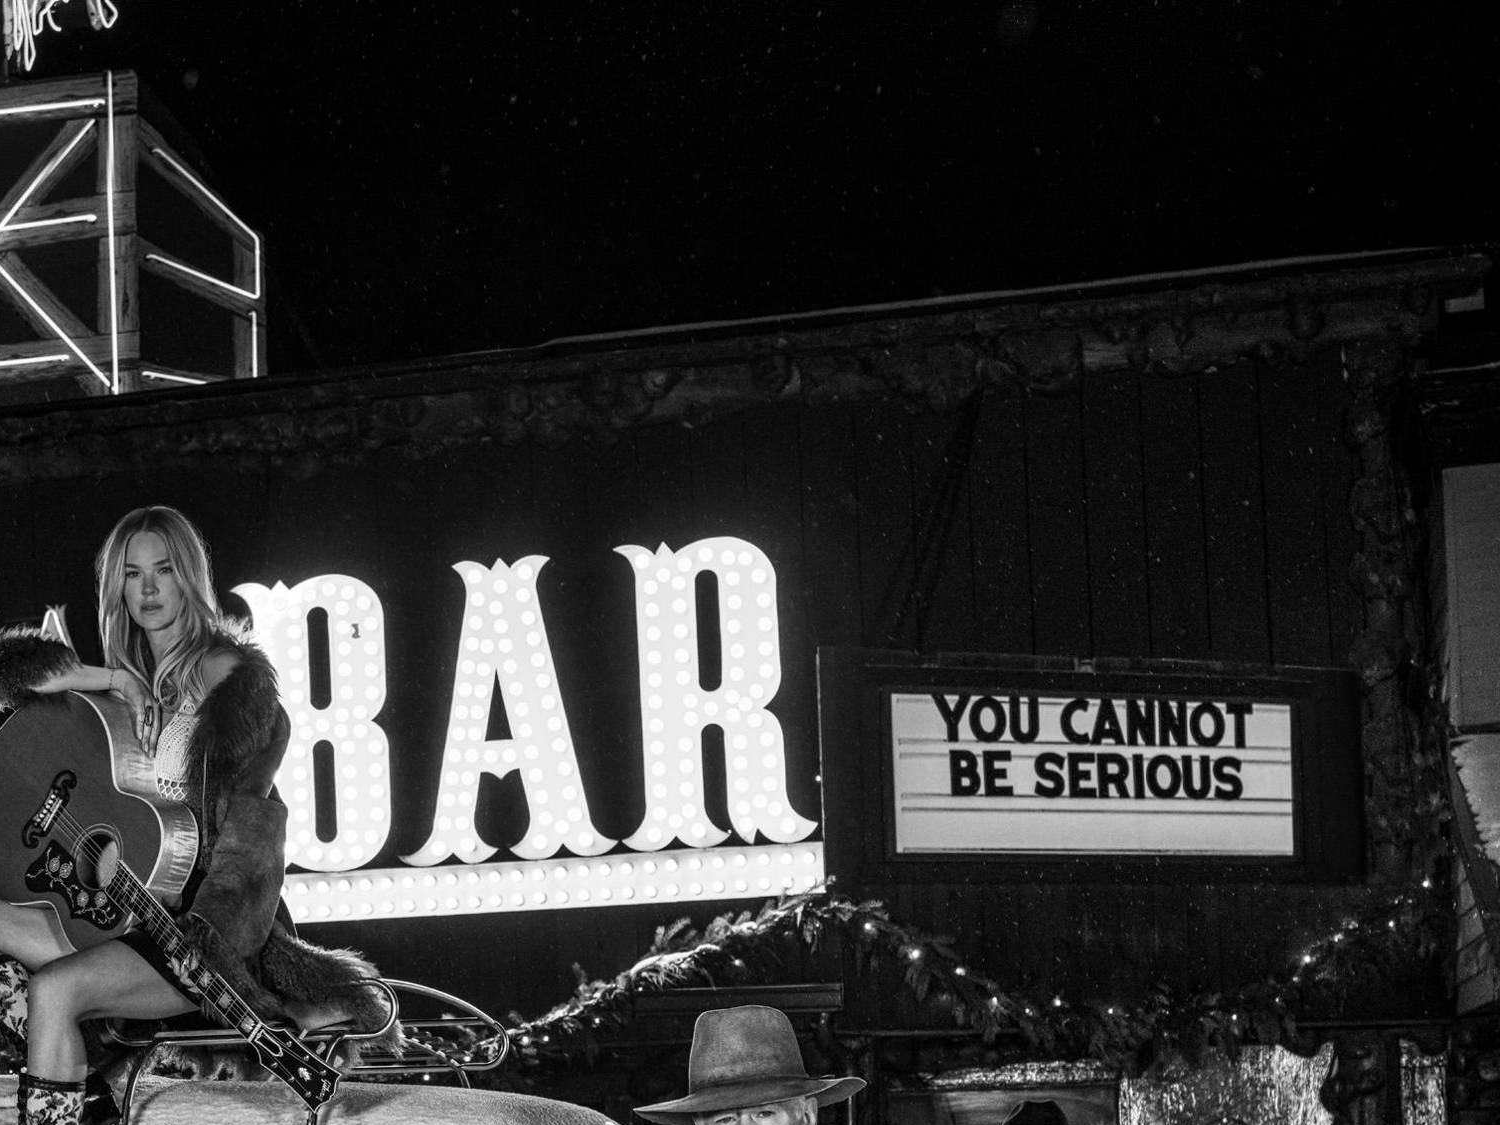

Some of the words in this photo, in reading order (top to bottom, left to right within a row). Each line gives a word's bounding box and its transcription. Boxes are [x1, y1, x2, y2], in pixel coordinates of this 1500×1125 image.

[230, 536, 818, 873] BAR
[930, 694, 1040, 743] YOU
[1059, 698, 1254, 749] CANNOT
[949, 750, 1014, 797] BE
[1034, 752, 1244, 800] SERIOUS
